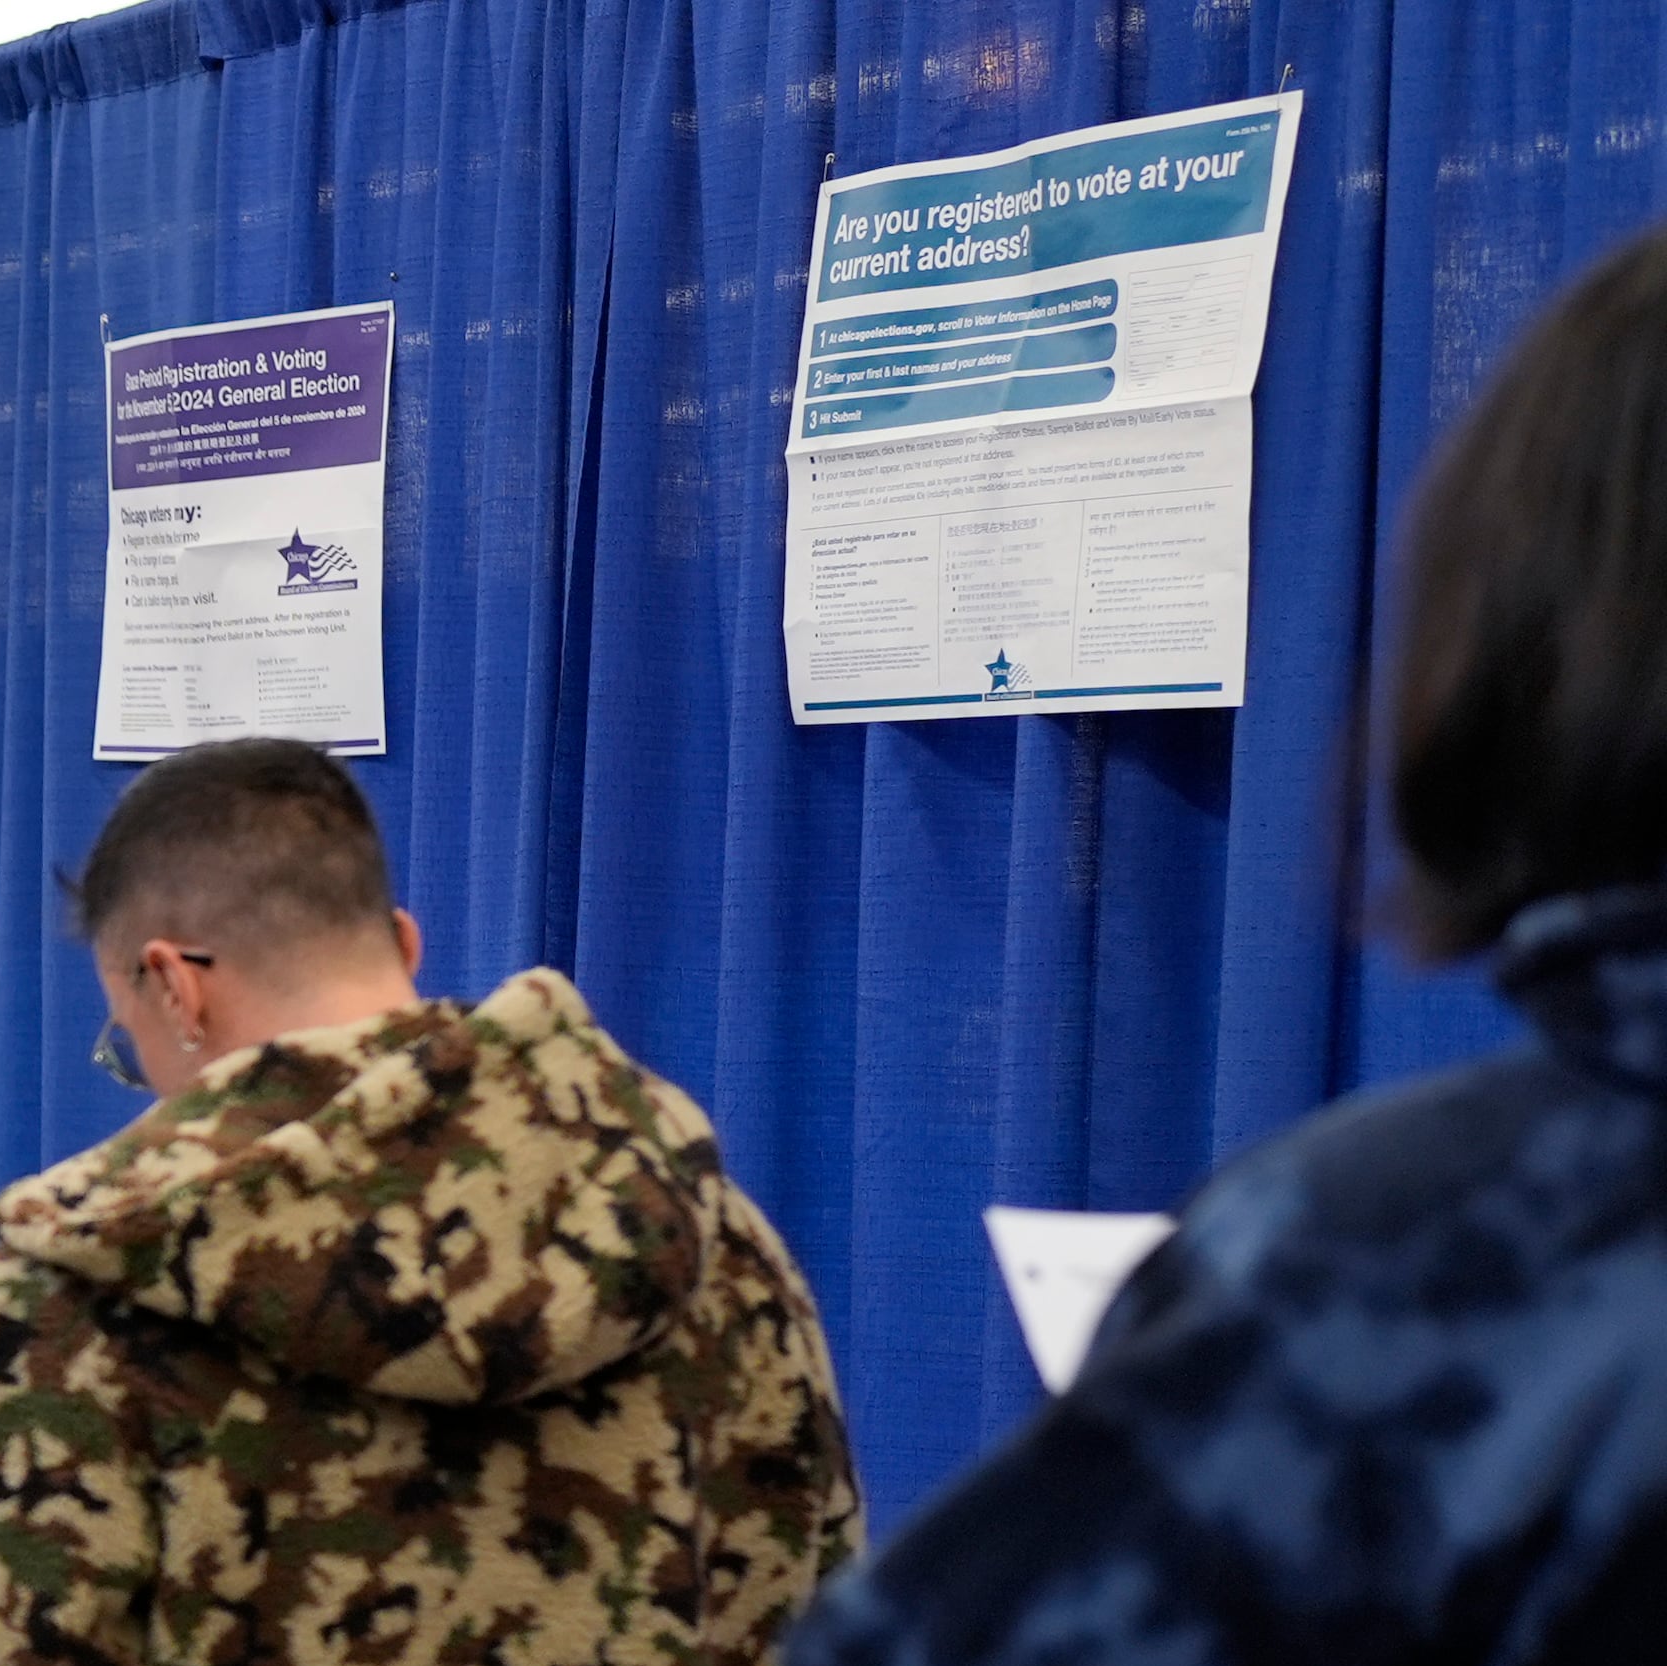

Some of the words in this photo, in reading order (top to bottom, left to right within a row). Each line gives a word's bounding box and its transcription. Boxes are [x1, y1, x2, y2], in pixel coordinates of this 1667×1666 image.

[833, 214, 868, 245] Are
[872, 208, 920, 243] you
[927, 179, 1044, 234] registered
[1048, 177, 1071, 208] to
[1077, 165, 1132, 202] vote
[1138, 156, 1169, 190] at
[1174, 150, 1245, 193] your
[829, 244, 912, 284] current
[917, 225, 1031, 271] address?
[820, 330, 827, 349] 1
[975, 314, 997, 326] Voter
[998, 307, 1046, 323] Information
[1071, 299, 1092, 312] Home
[1093, 294, 1113, 309] Page
[255, 352, 268, 374] &
[272, 348, 327, 371] Voting
[813, 370, 823, 389] 2
[824, 373, 845, 385] Enter
[846, 369, 867, 385] your
[941, 359, 957, 372] and
[957, 357, 978, 371] your
[977, 352, 1012, 367] address
[218, 379, 286, 407] General
[290, 372, 360, 399] Election
[227, 417, 259, 432] General
[280, 413, 292, 425] de
[809, 410, 817, 430] 3
[819, 413, 831, 424] Hit
[831, 410, 862, 424] Submit
